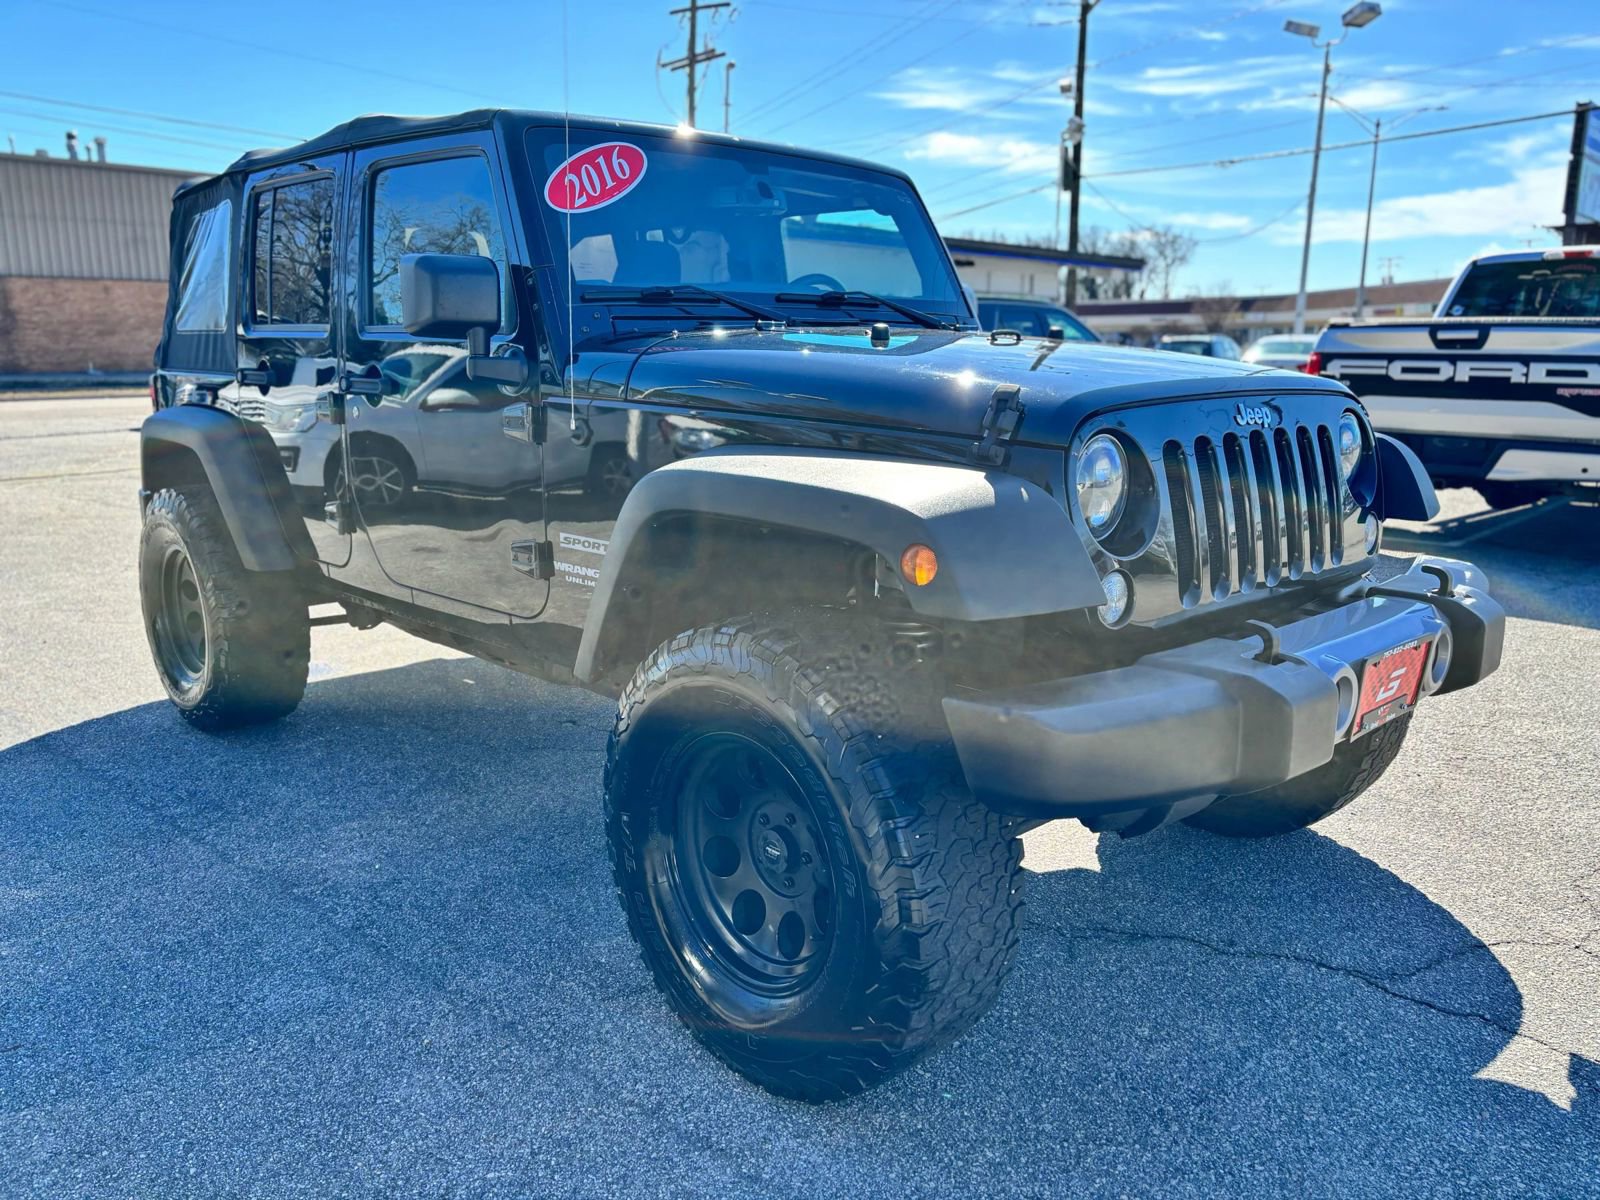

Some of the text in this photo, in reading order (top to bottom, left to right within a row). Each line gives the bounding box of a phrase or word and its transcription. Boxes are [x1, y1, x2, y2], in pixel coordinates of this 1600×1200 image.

[565, 146, 630, 208] 2016
[1326, 358, 1600, 386] FORD
[1235, 403, 1271, 428] Jeep
[560, 536, 609, 552] SPORT
